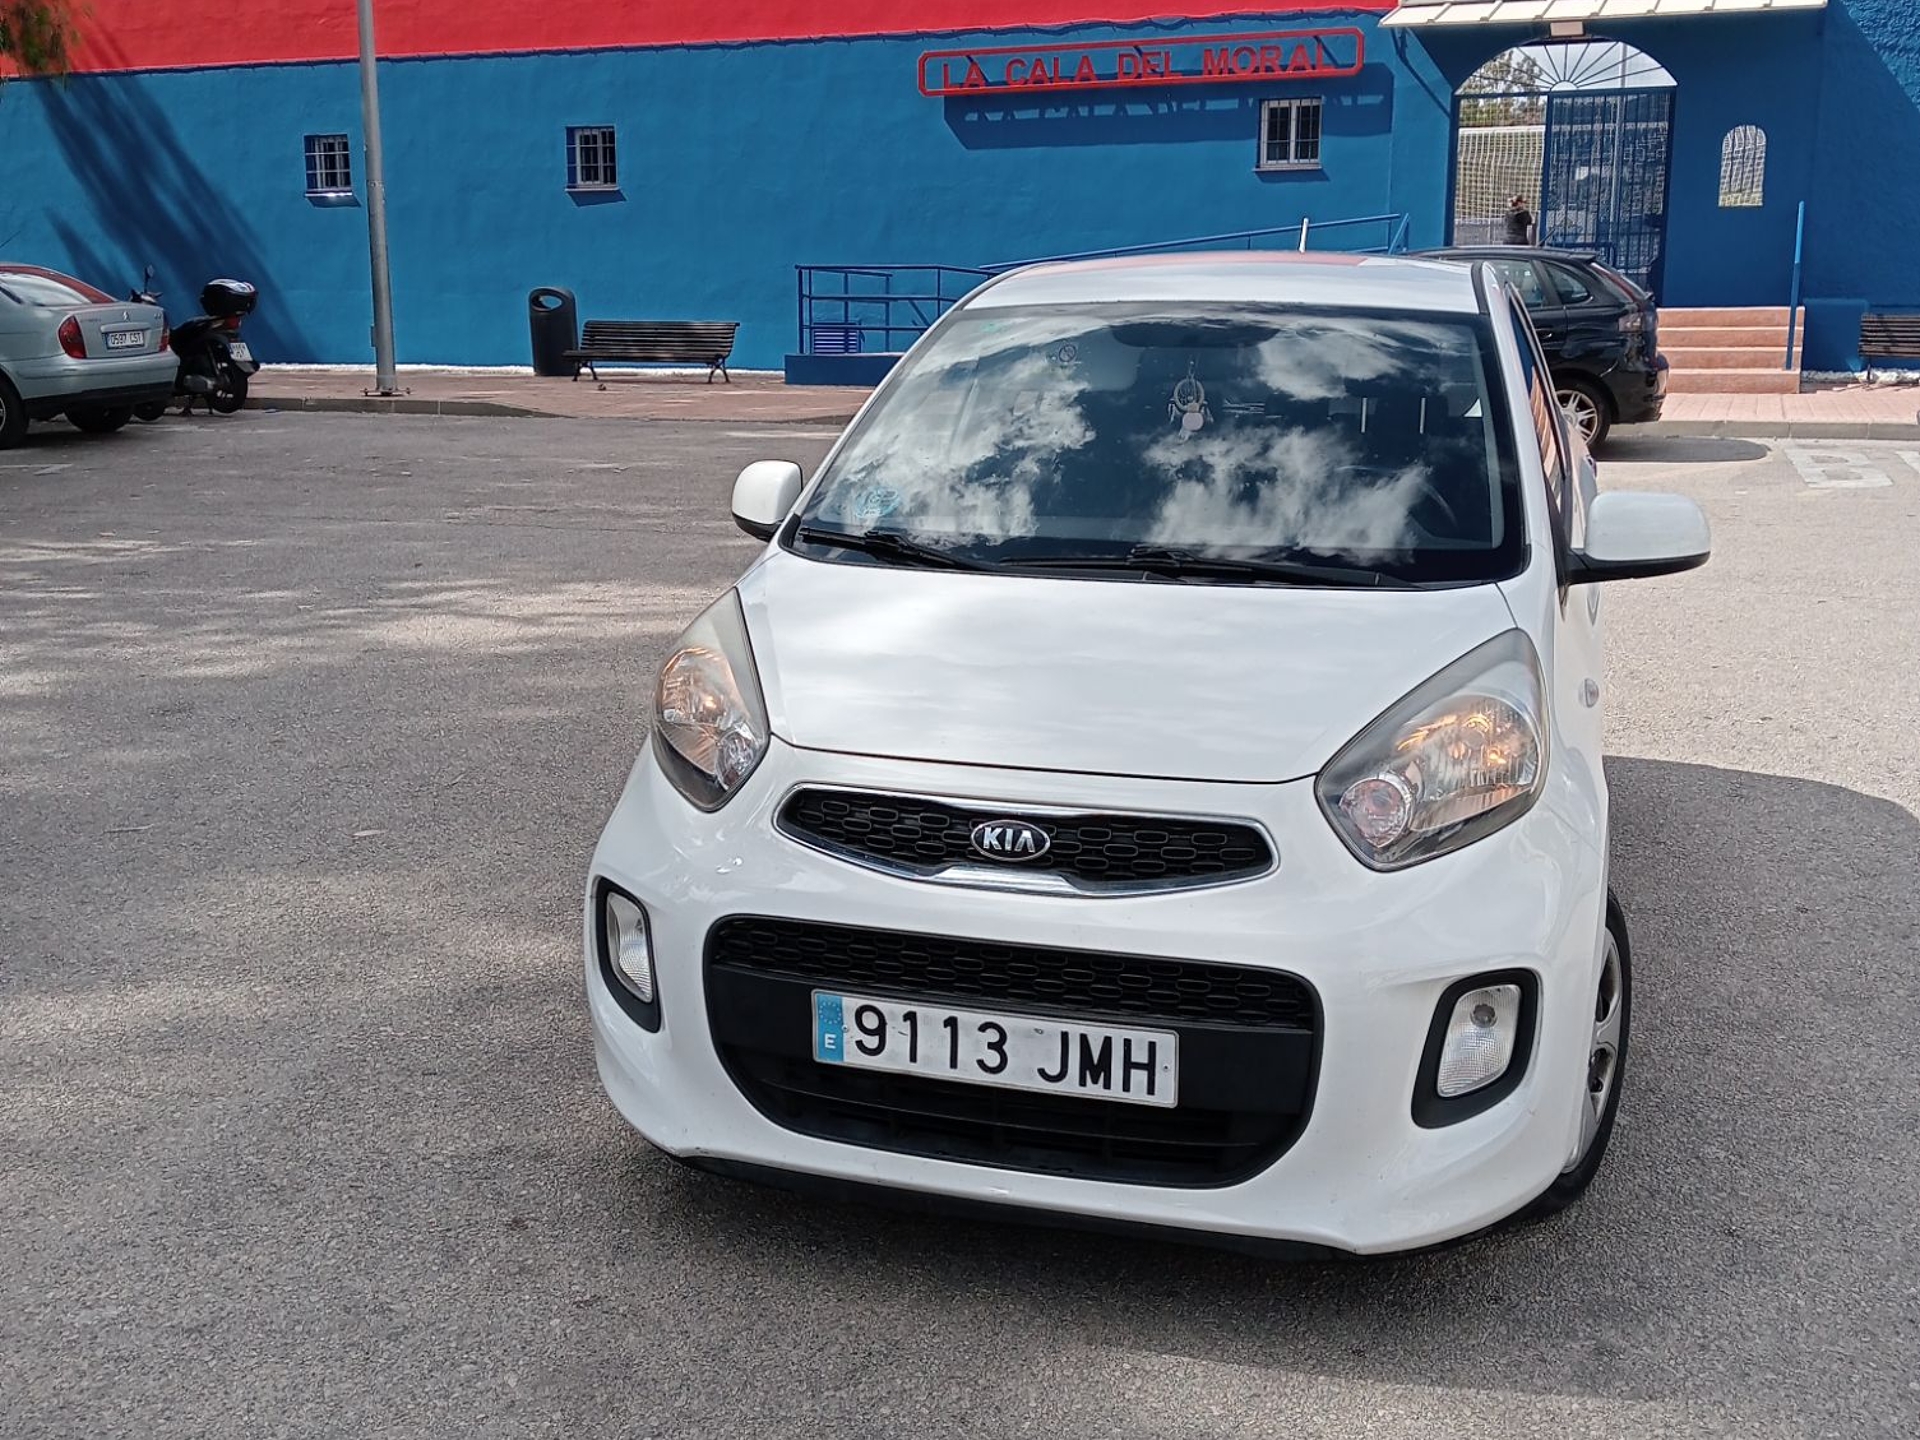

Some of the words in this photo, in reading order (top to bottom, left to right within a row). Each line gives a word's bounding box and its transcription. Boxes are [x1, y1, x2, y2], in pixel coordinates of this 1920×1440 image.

[943, 61, 986, 90] LA
[1005, 55, 1099, 86] CALA
[1117, 50, 1183, 81] DEL
[1203, 42, 1336, 77] MORAL
[983, 826, 1036, 853] KIA
[824, 1033, 837, 1049] E
[854, 1004, 1008, 1075] 9113
[1036, 1030, 1157, 1096] JMH
